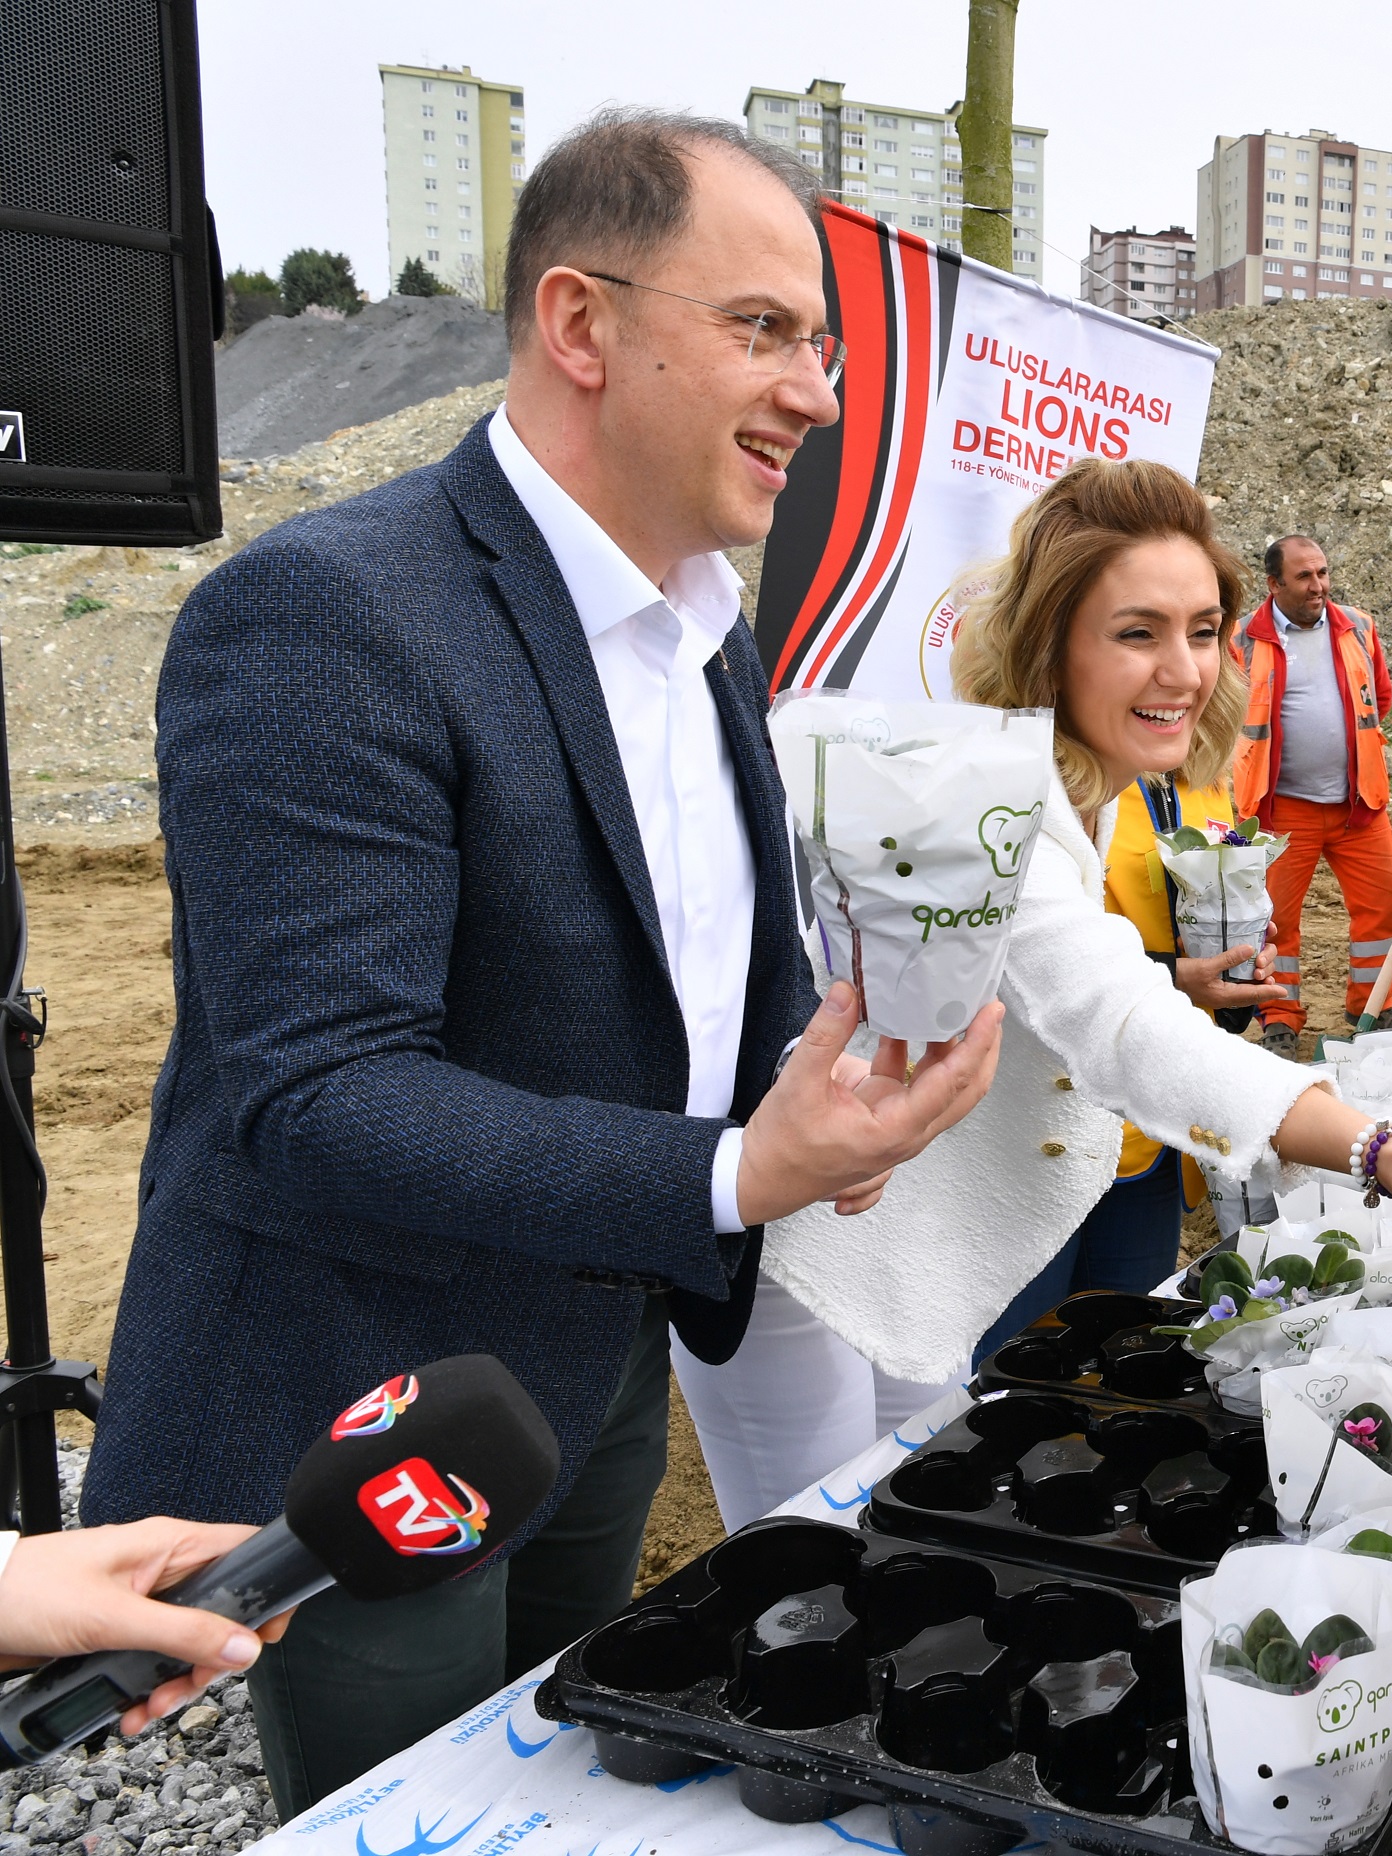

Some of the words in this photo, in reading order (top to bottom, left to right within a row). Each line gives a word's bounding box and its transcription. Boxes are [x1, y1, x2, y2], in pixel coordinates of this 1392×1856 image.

[965, 333, 1172, 426] ULUSLARARASI
[953, 419, 1073, 480] DERNE
[1000, 378, 1130, 461] LIONS
[950, 459, 985, 475] 118-E
[375, 1470, 449, 1536] TV
[450, 1680, 543, 1745] BEYLİKDÜZÜ
[295, 1778, 406, 1834] BEYLİKDÜZÜ
